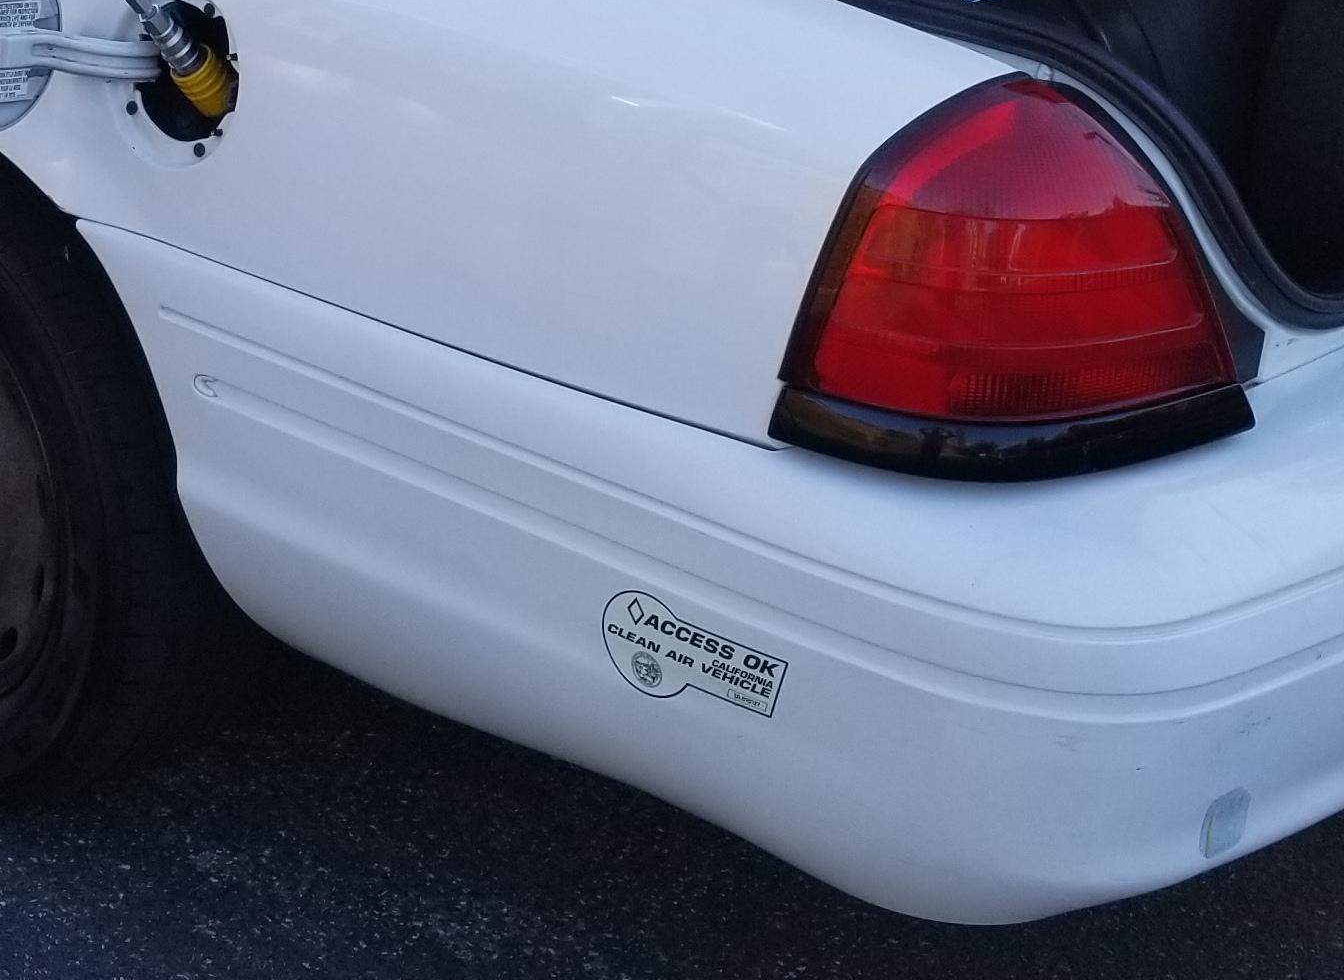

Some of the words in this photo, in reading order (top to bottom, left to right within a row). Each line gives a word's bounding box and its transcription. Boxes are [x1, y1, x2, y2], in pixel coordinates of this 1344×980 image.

[607, 623, 661, 653] CLEAN
[665, 650, 695, 667] AIR
[701, 662, 773, 698] VEHICLE
[643, 613, 735, 660] ACCESS
[743, 654, 780, 678] OK
[712, 659, 773, 689] CALIFORNIA
